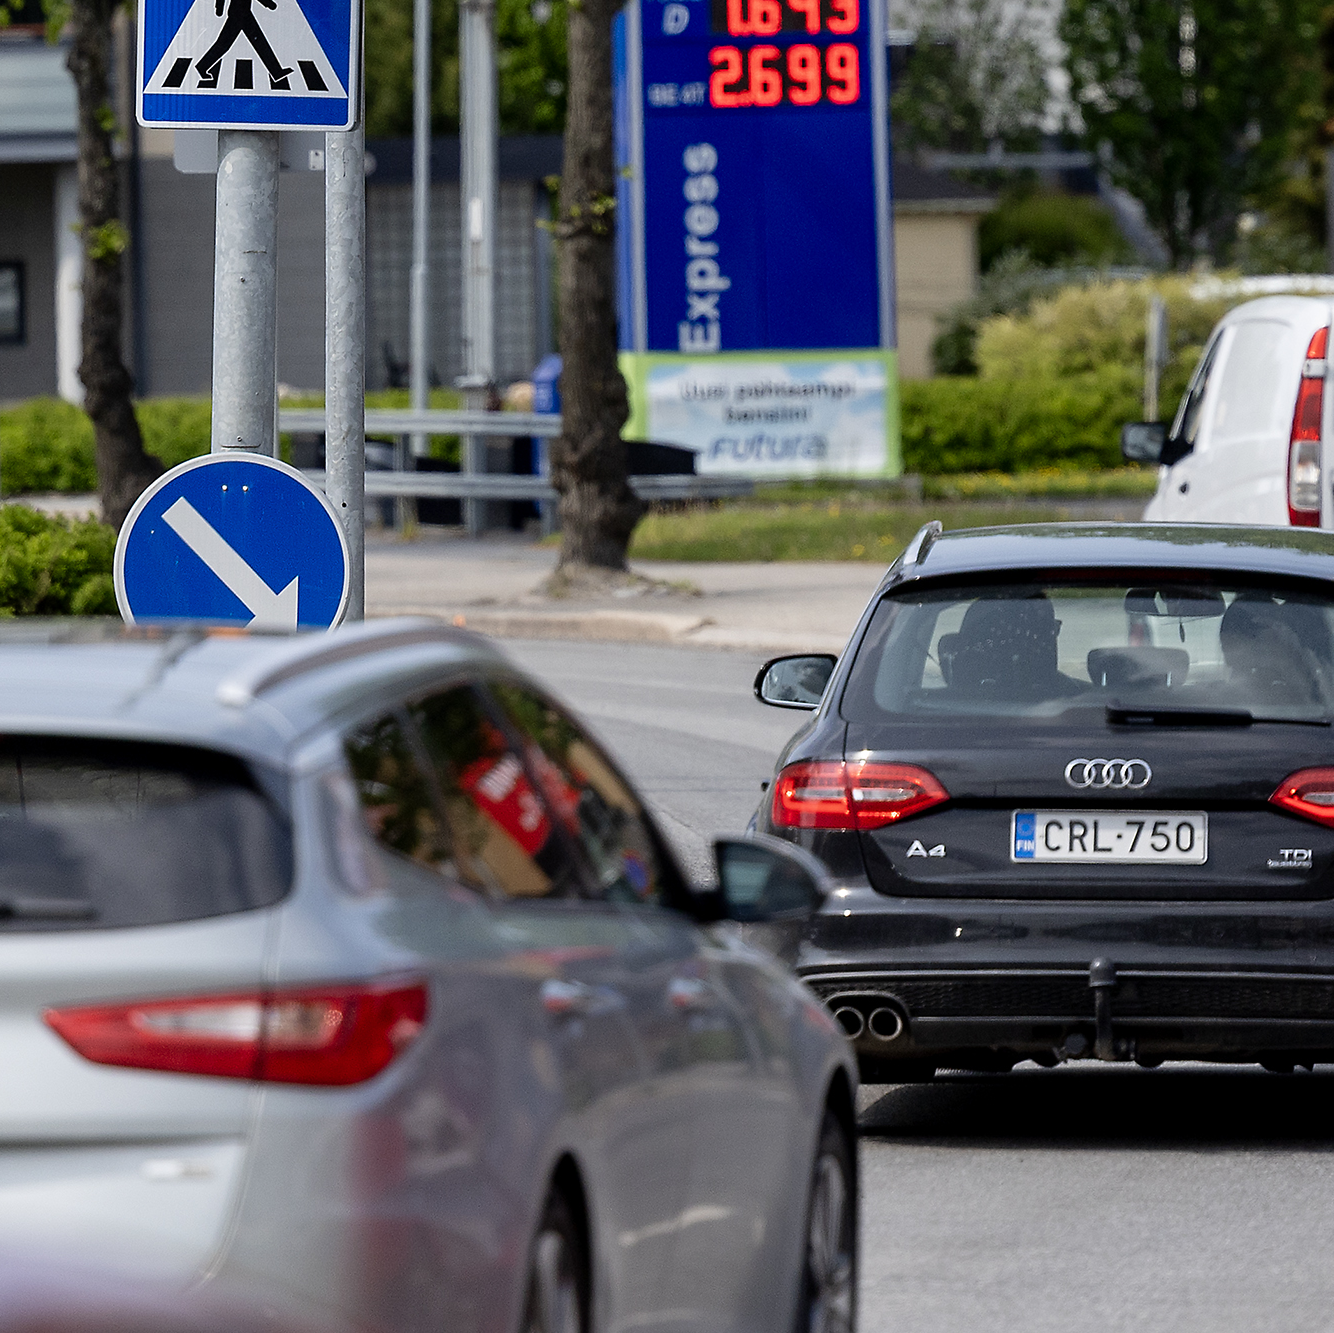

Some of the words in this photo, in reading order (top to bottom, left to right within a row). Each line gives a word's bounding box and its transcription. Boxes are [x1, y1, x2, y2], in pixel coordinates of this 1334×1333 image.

[663, 3, 690, 35] D
[677, 142, 731, 353] Express
[907, 839, 946, 858] A4
[1017, 840, 1035, 851] FIN
[1044, 820, 1195, 853] CRL-750
[1279, 848, 1312, 862] TDI
